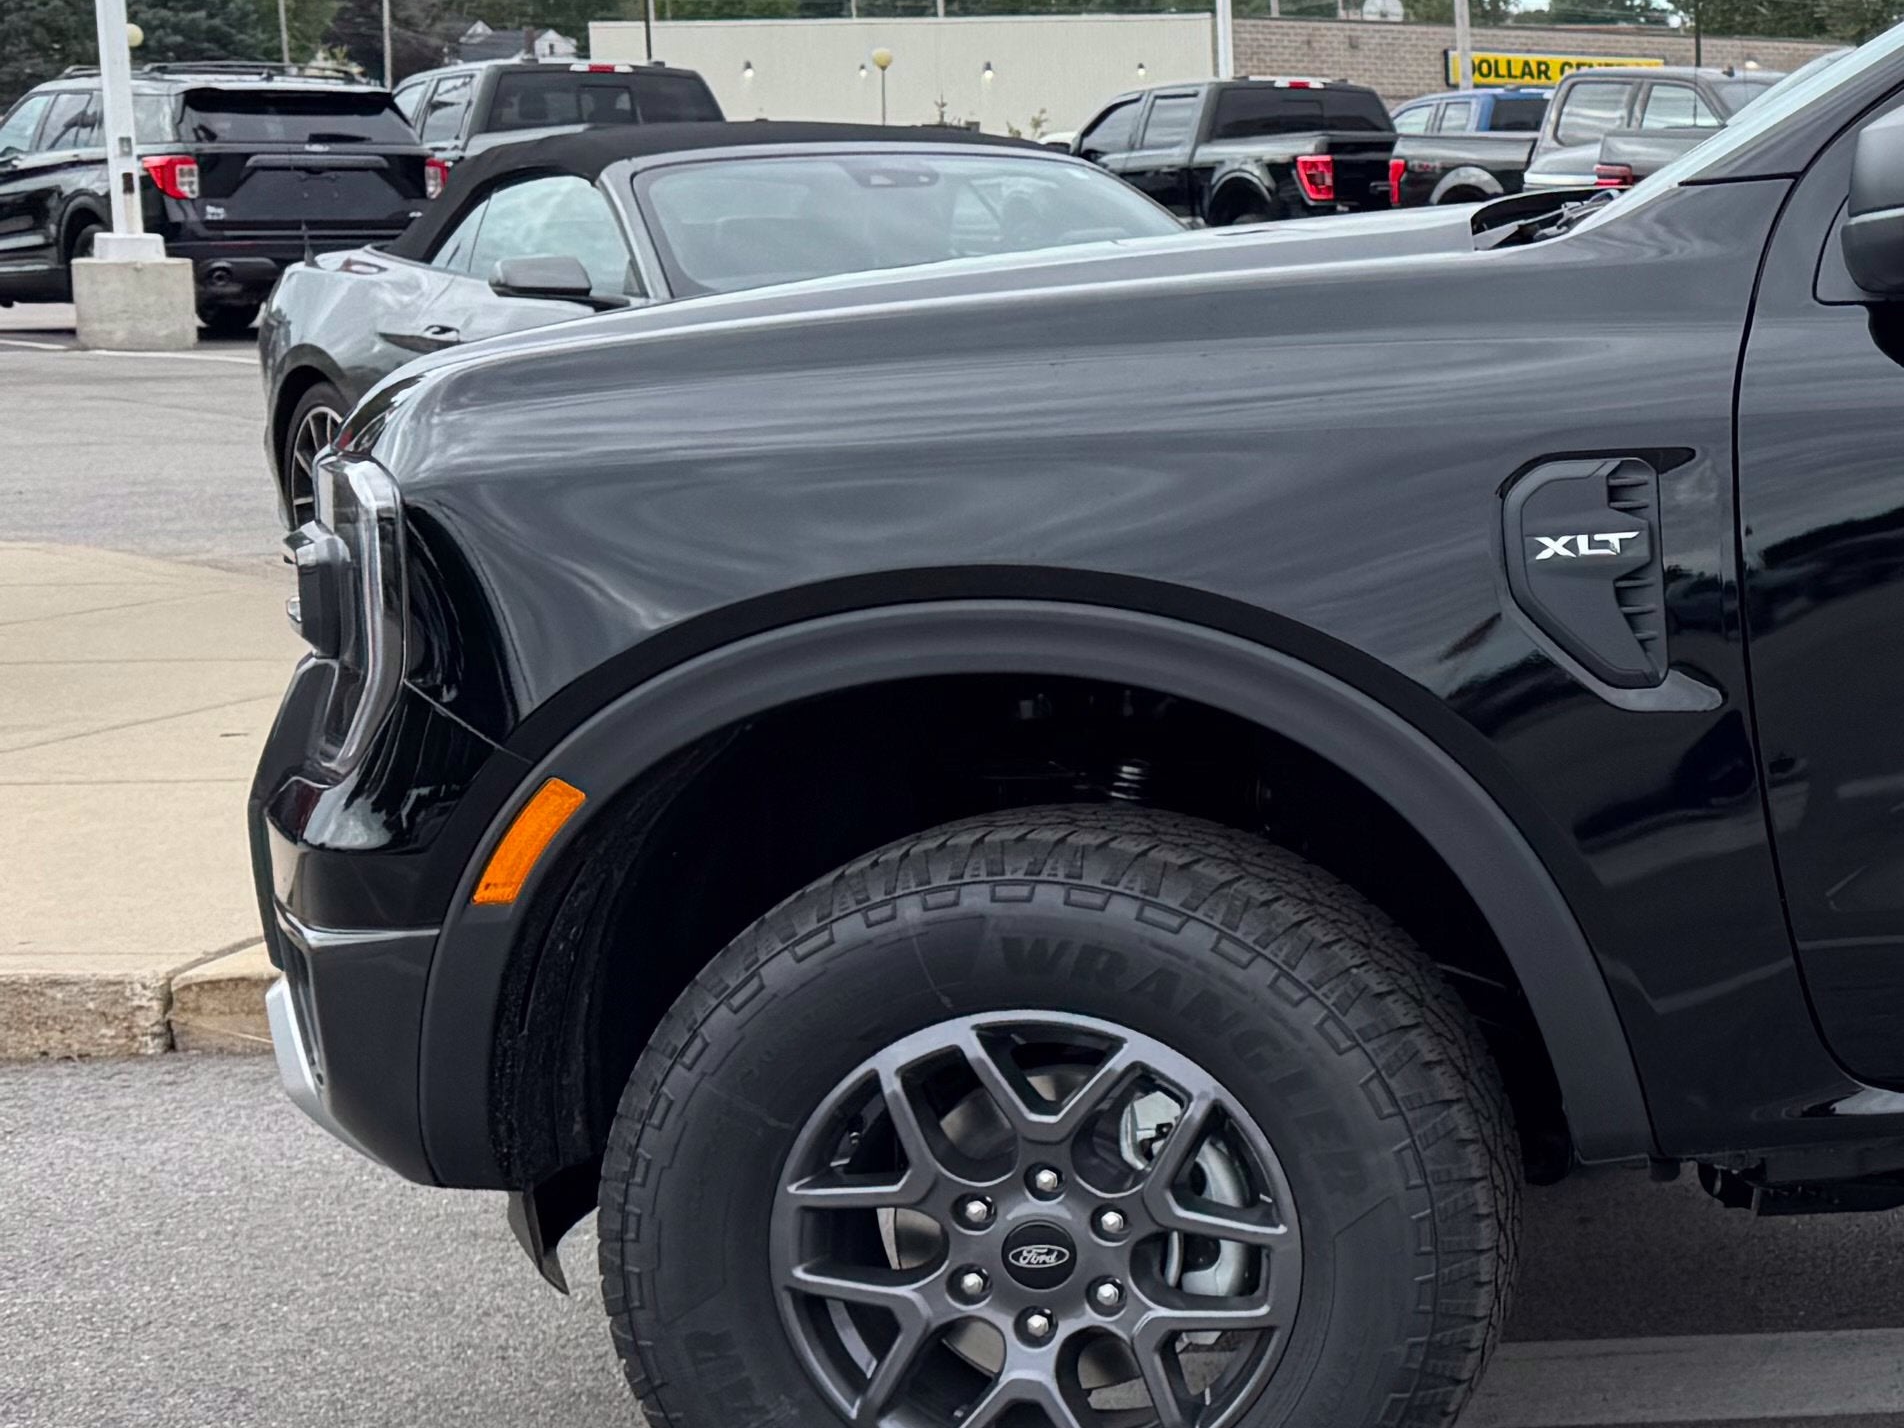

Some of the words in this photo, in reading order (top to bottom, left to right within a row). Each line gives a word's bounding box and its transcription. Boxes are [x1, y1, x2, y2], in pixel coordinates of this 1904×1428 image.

[1533, 531, 1641, 560] XLT
[998, 933, 1374, 1196] WRANGLER
[1019, 1248, 1058, 1265] Ford
